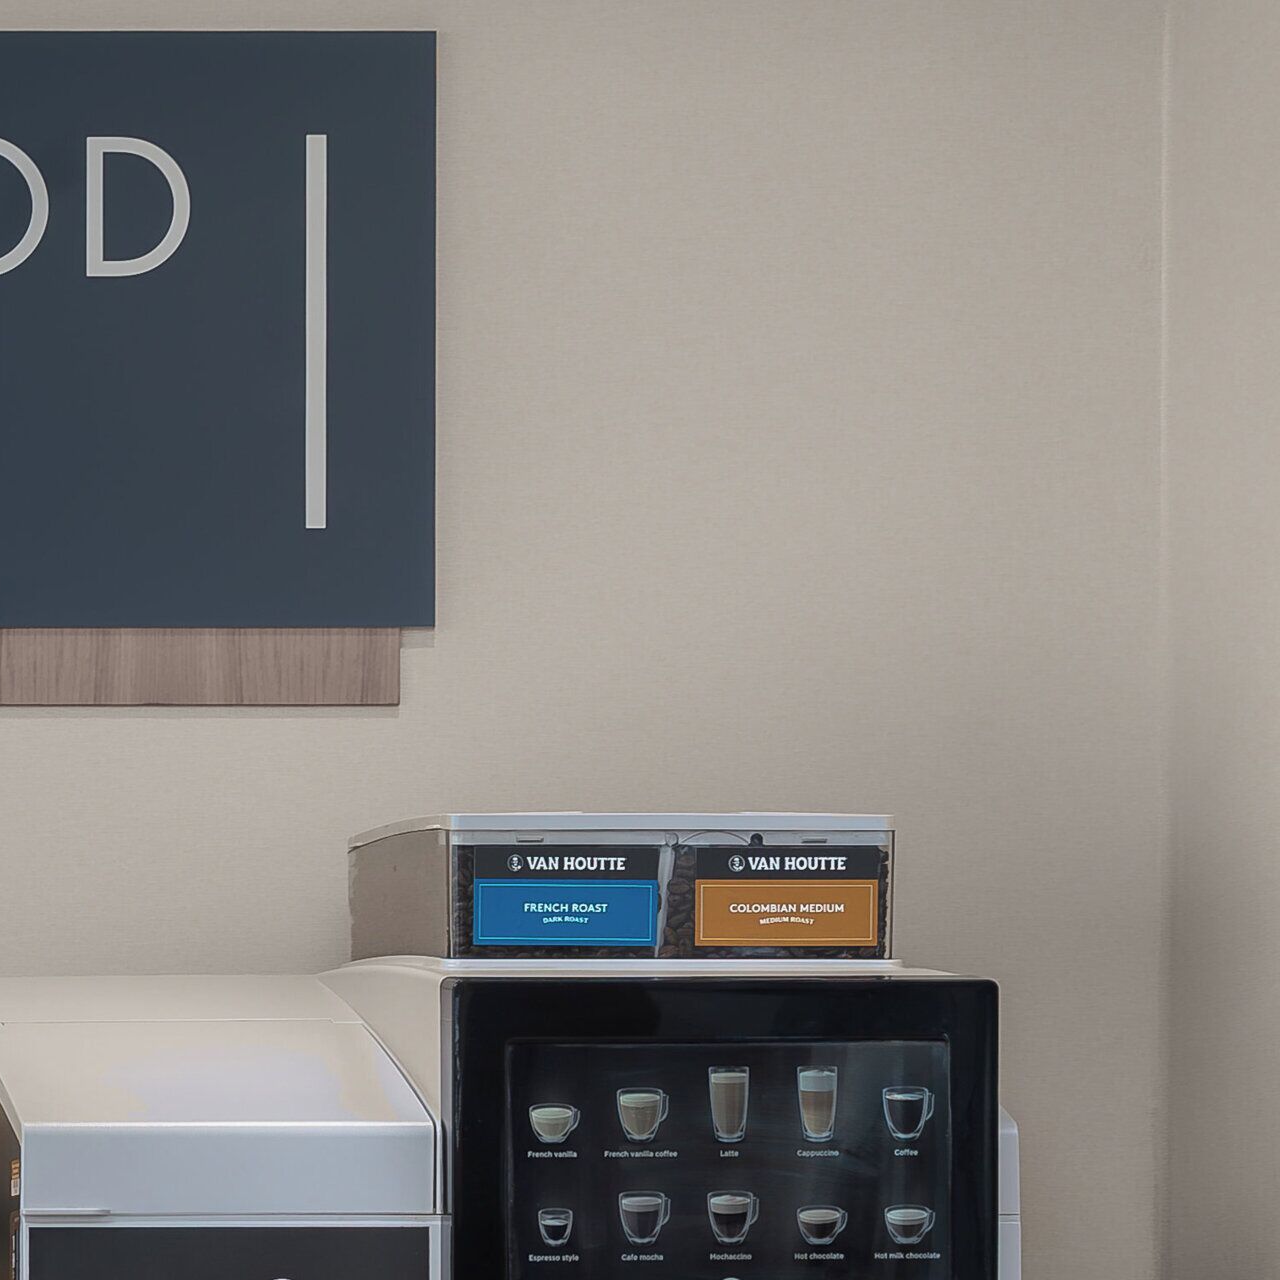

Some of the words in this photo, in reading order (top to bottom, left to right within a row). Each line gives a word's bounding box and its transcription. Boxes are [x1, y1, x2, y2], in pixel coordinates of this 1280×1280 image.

[526, 857, 560, 871] VAN
[563, 856, 626, 871] HOUTTE
[748, 857, 781, 871] VAN
[784, 856, 847, 871] HOUTTE
[523, 903, 568, 914] FRENCH
[571, 903, 608, 914] ROAST
[729, 903, 797, 914] COLOMBIAN
[800, 903, 845, 914] MEDIUM
[543, 916, 563, 924] DARK
[564, 916, 589, 924] ROAST
[759, 917, 789, 925] MEDIUM
[790, 917, 815, 925] ROAST
[562, 1254, 579, 1262] style
